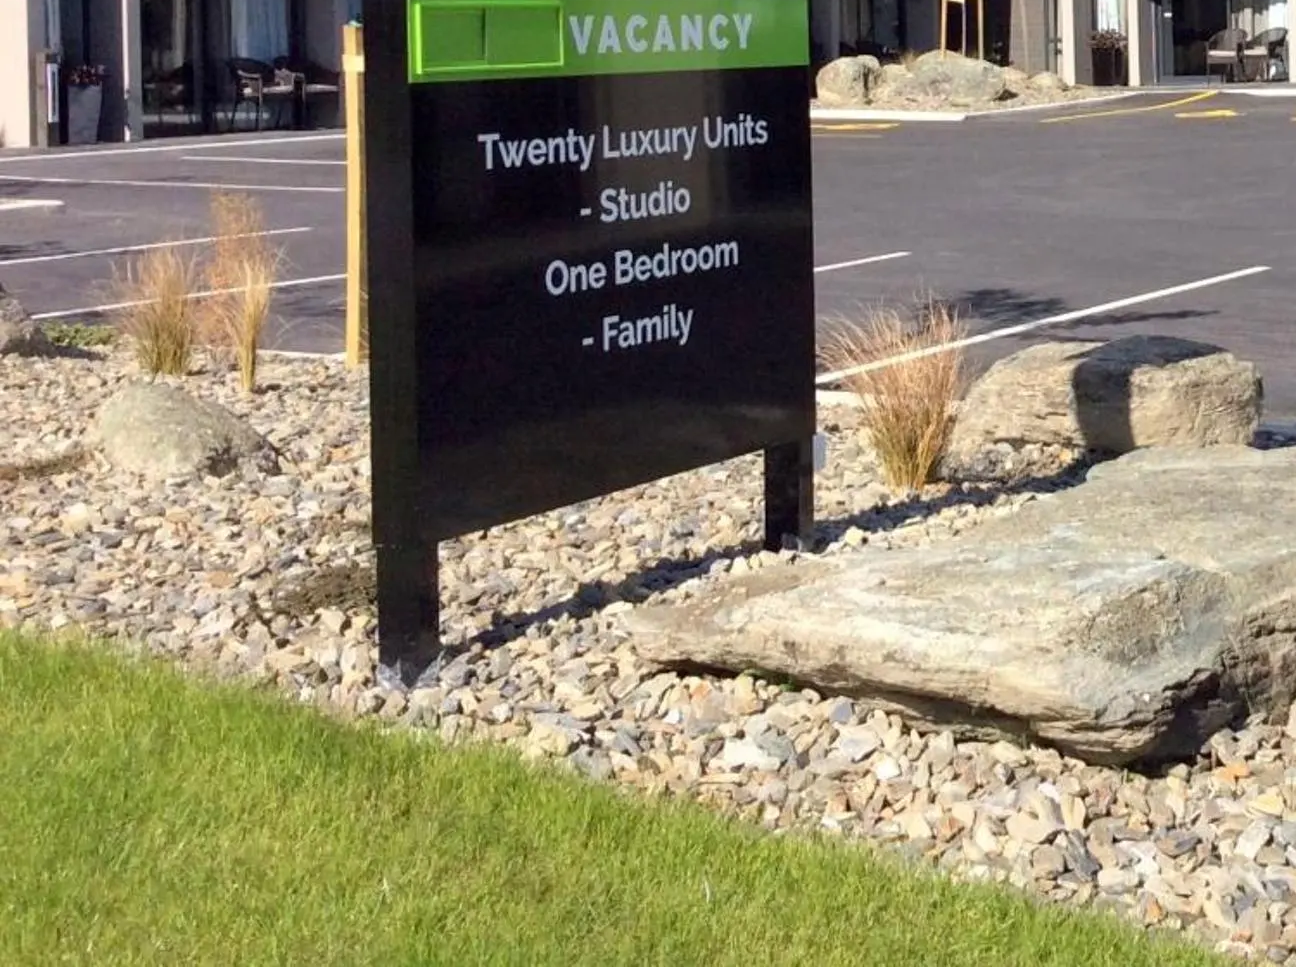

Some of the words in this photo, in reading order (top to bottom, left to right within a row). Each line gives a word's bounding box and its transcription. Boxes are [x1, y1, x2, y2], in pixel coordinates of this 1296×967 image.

[569, 13, 752, 55] VACANCY
[477, 128, 595, 171] Twenty
[602, 125, 697, 161] Luxury
[703, 113, 768, 149] Units
[600, 180, 691, 223] Studio
[545, 259, 607, 296] One
[614, 240, 739, 285] Bedroom
[603, 303, 693, 351] Family
